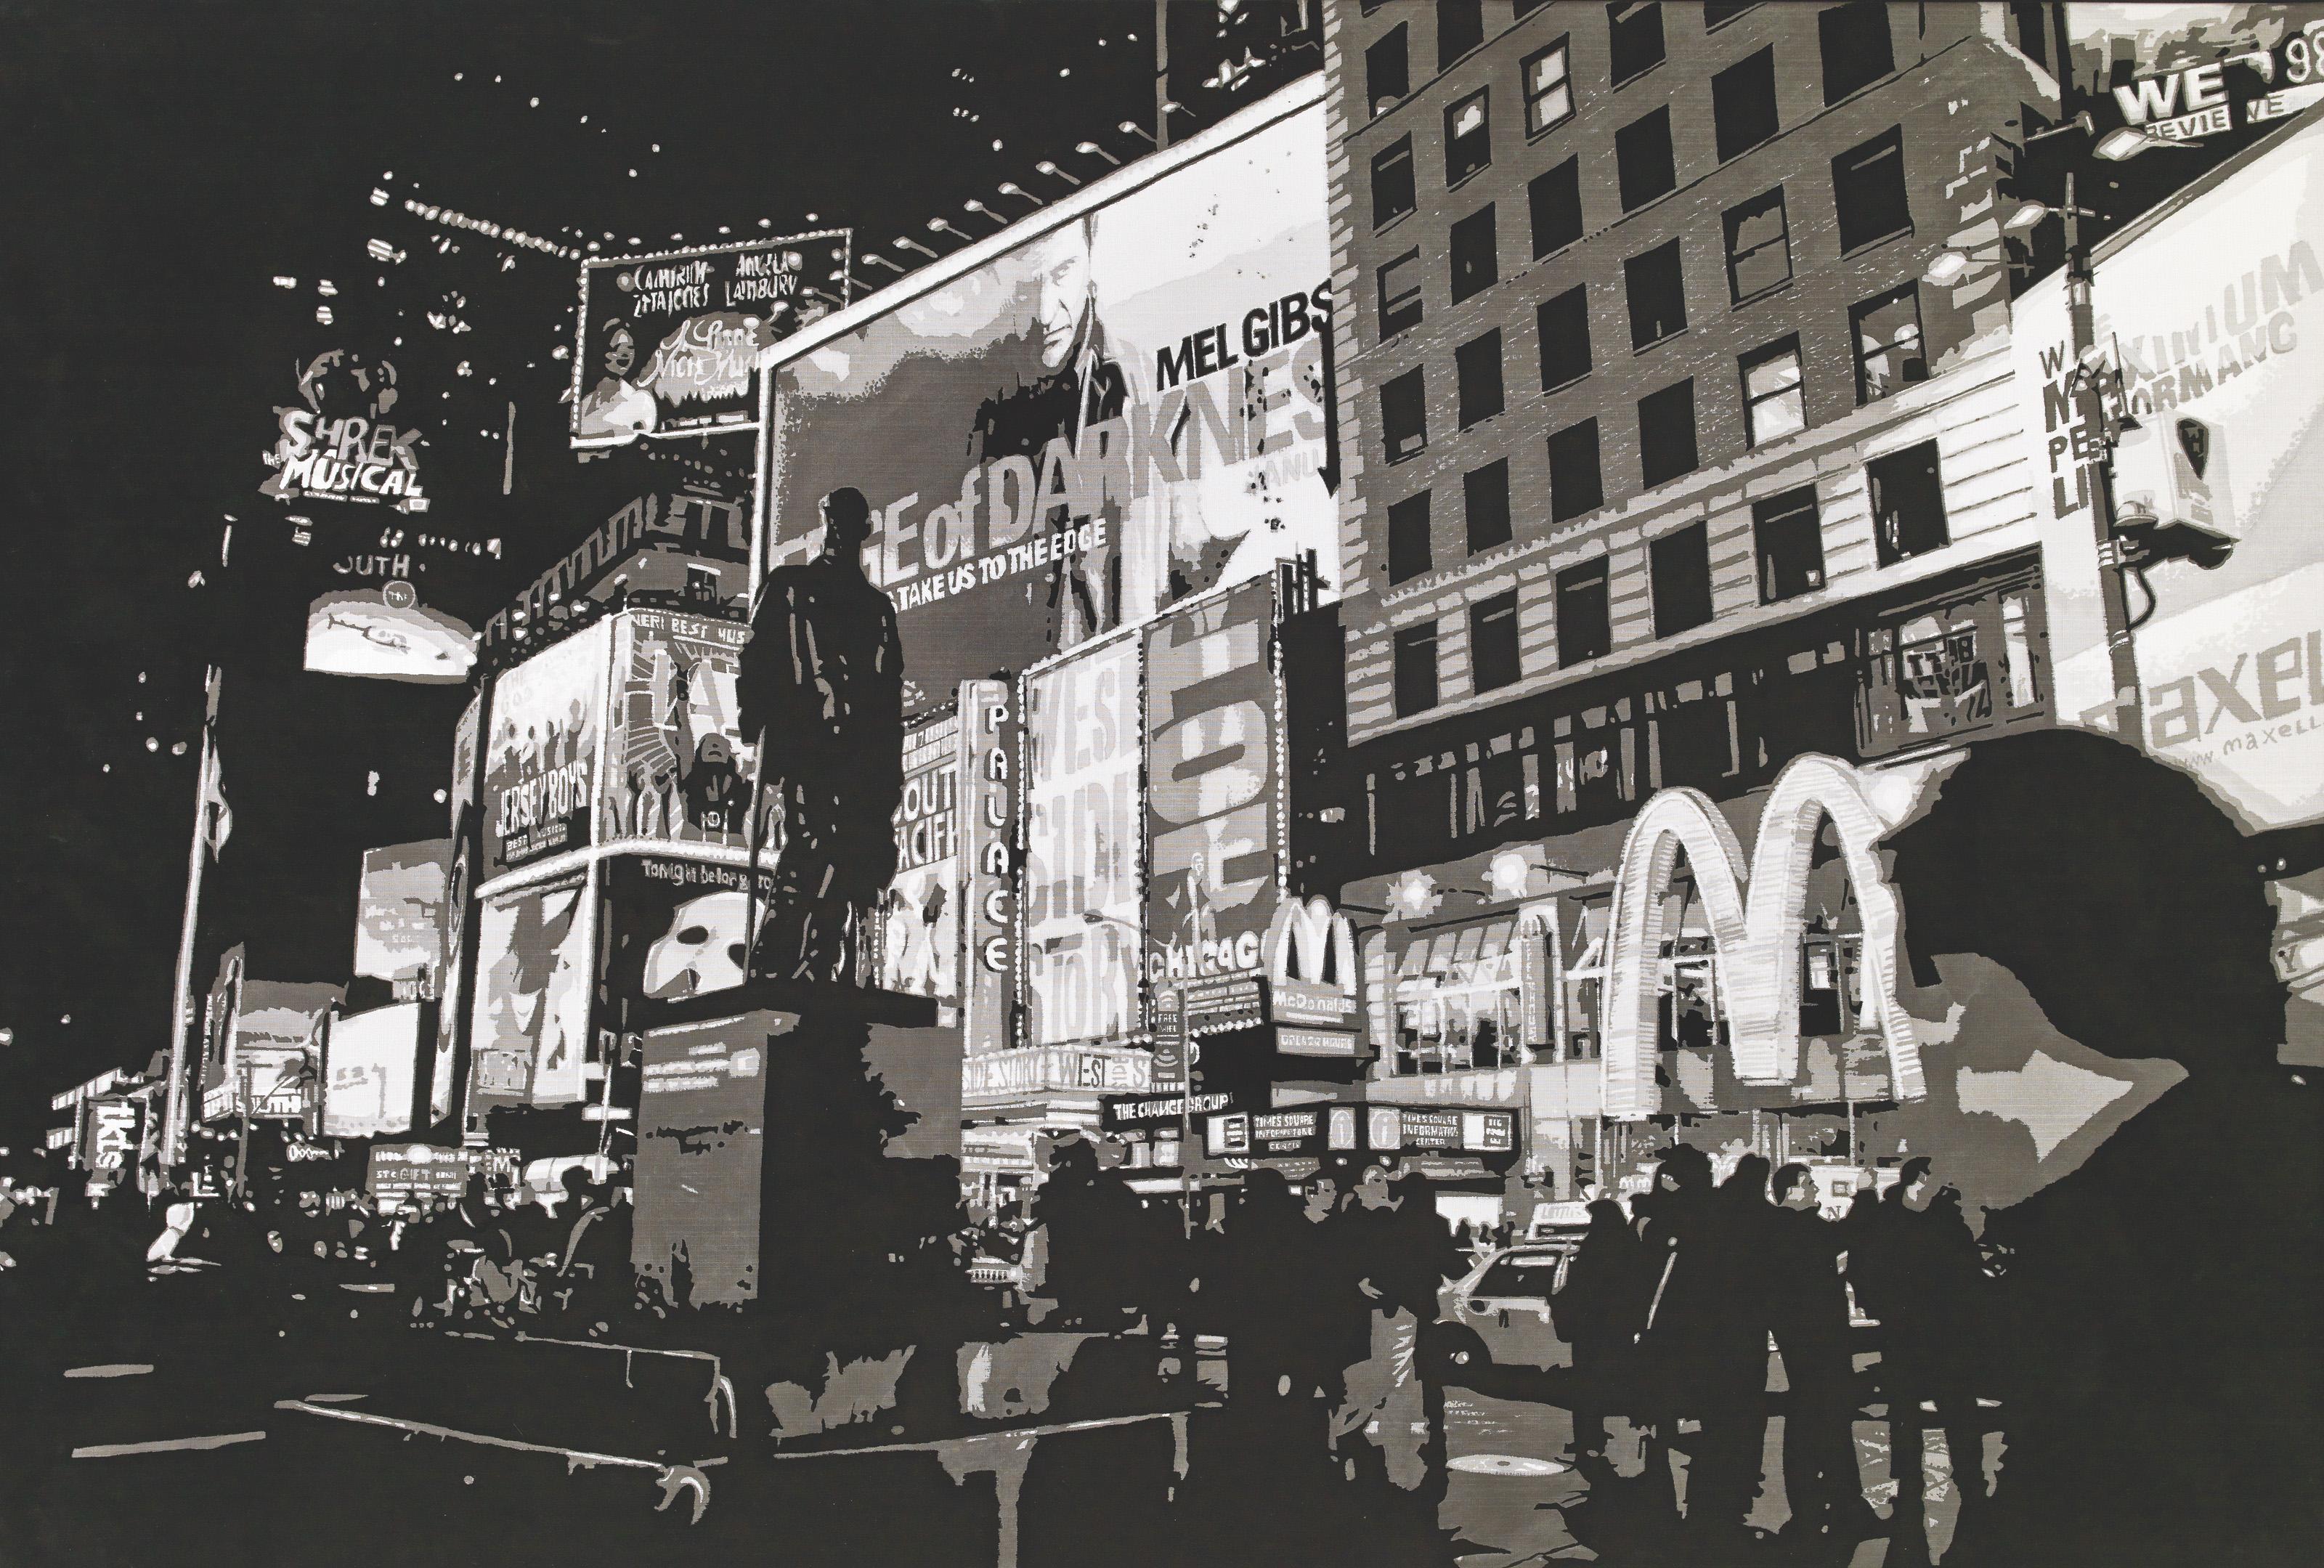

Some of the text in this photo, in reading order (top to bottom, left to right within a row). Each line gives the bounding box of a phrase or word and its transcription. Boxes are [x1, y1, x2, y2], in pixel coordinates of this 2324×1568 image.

[2113, 61, 2230, 126] WE
[1158, 277, 1335, 392] MEL GIBS
[279, 407, 423, 471] SHREK
[279, 448, 423, 497] MUSICAL
[923, 462, 983, 570] of
[897, 574, 946, 612] TAKE
[947, 563, 977, 595] US
[978, 552, 1008, 585] TO
[1009, 537, 1049, 578] THE
[1049, 516, 1110, 562] EDGE
[671, 619, 708, 639] BEST
[495, 773, 547, 838] JERSEY
[548, 758, 588, 819] BOYS
[984, 703, 1009, 972] PALACE
[1113, 1102, 1137, 1121] THE
[1188, 1093, 1230, 1113] GROUP
